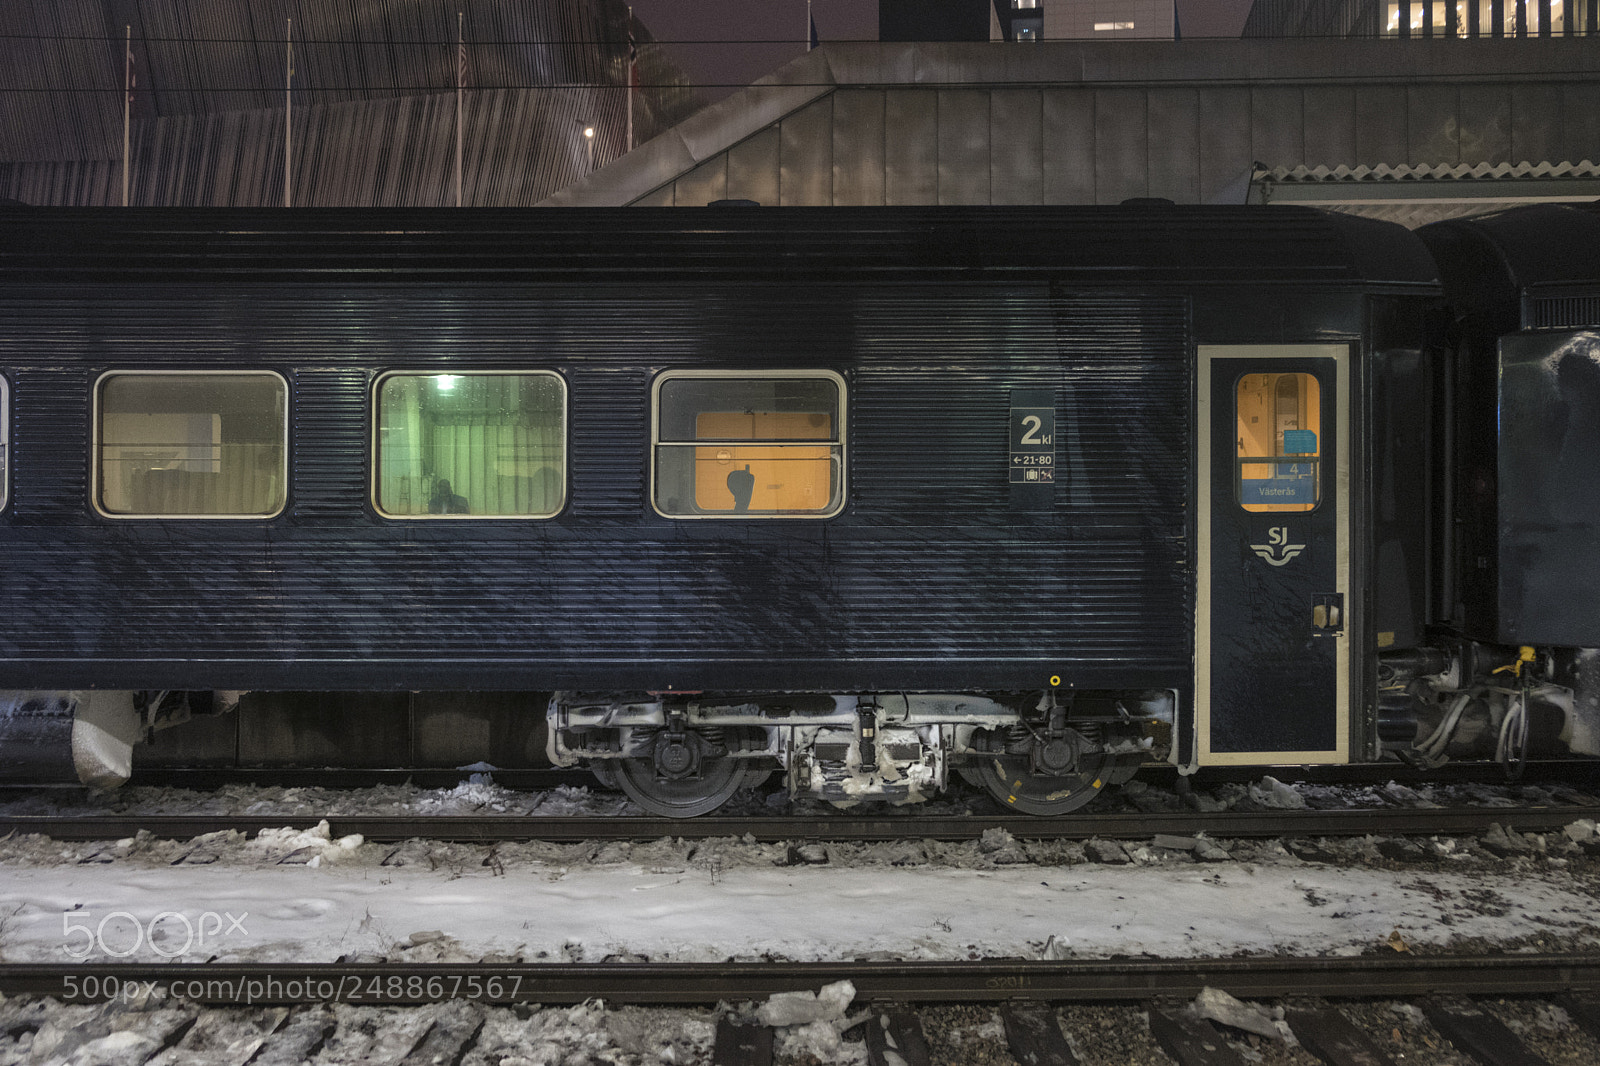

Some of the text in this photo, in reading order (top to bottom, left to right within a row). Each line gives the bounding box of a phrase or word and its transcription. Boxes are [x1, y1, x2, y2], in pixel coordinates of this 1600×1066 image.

[1020, 415, 1041, 445] 2
[1023, 455, 1052, 465] 21-80
[1258, 486, 1296, 497] Västerås
[1268, 526, 1288, 546] SJ
